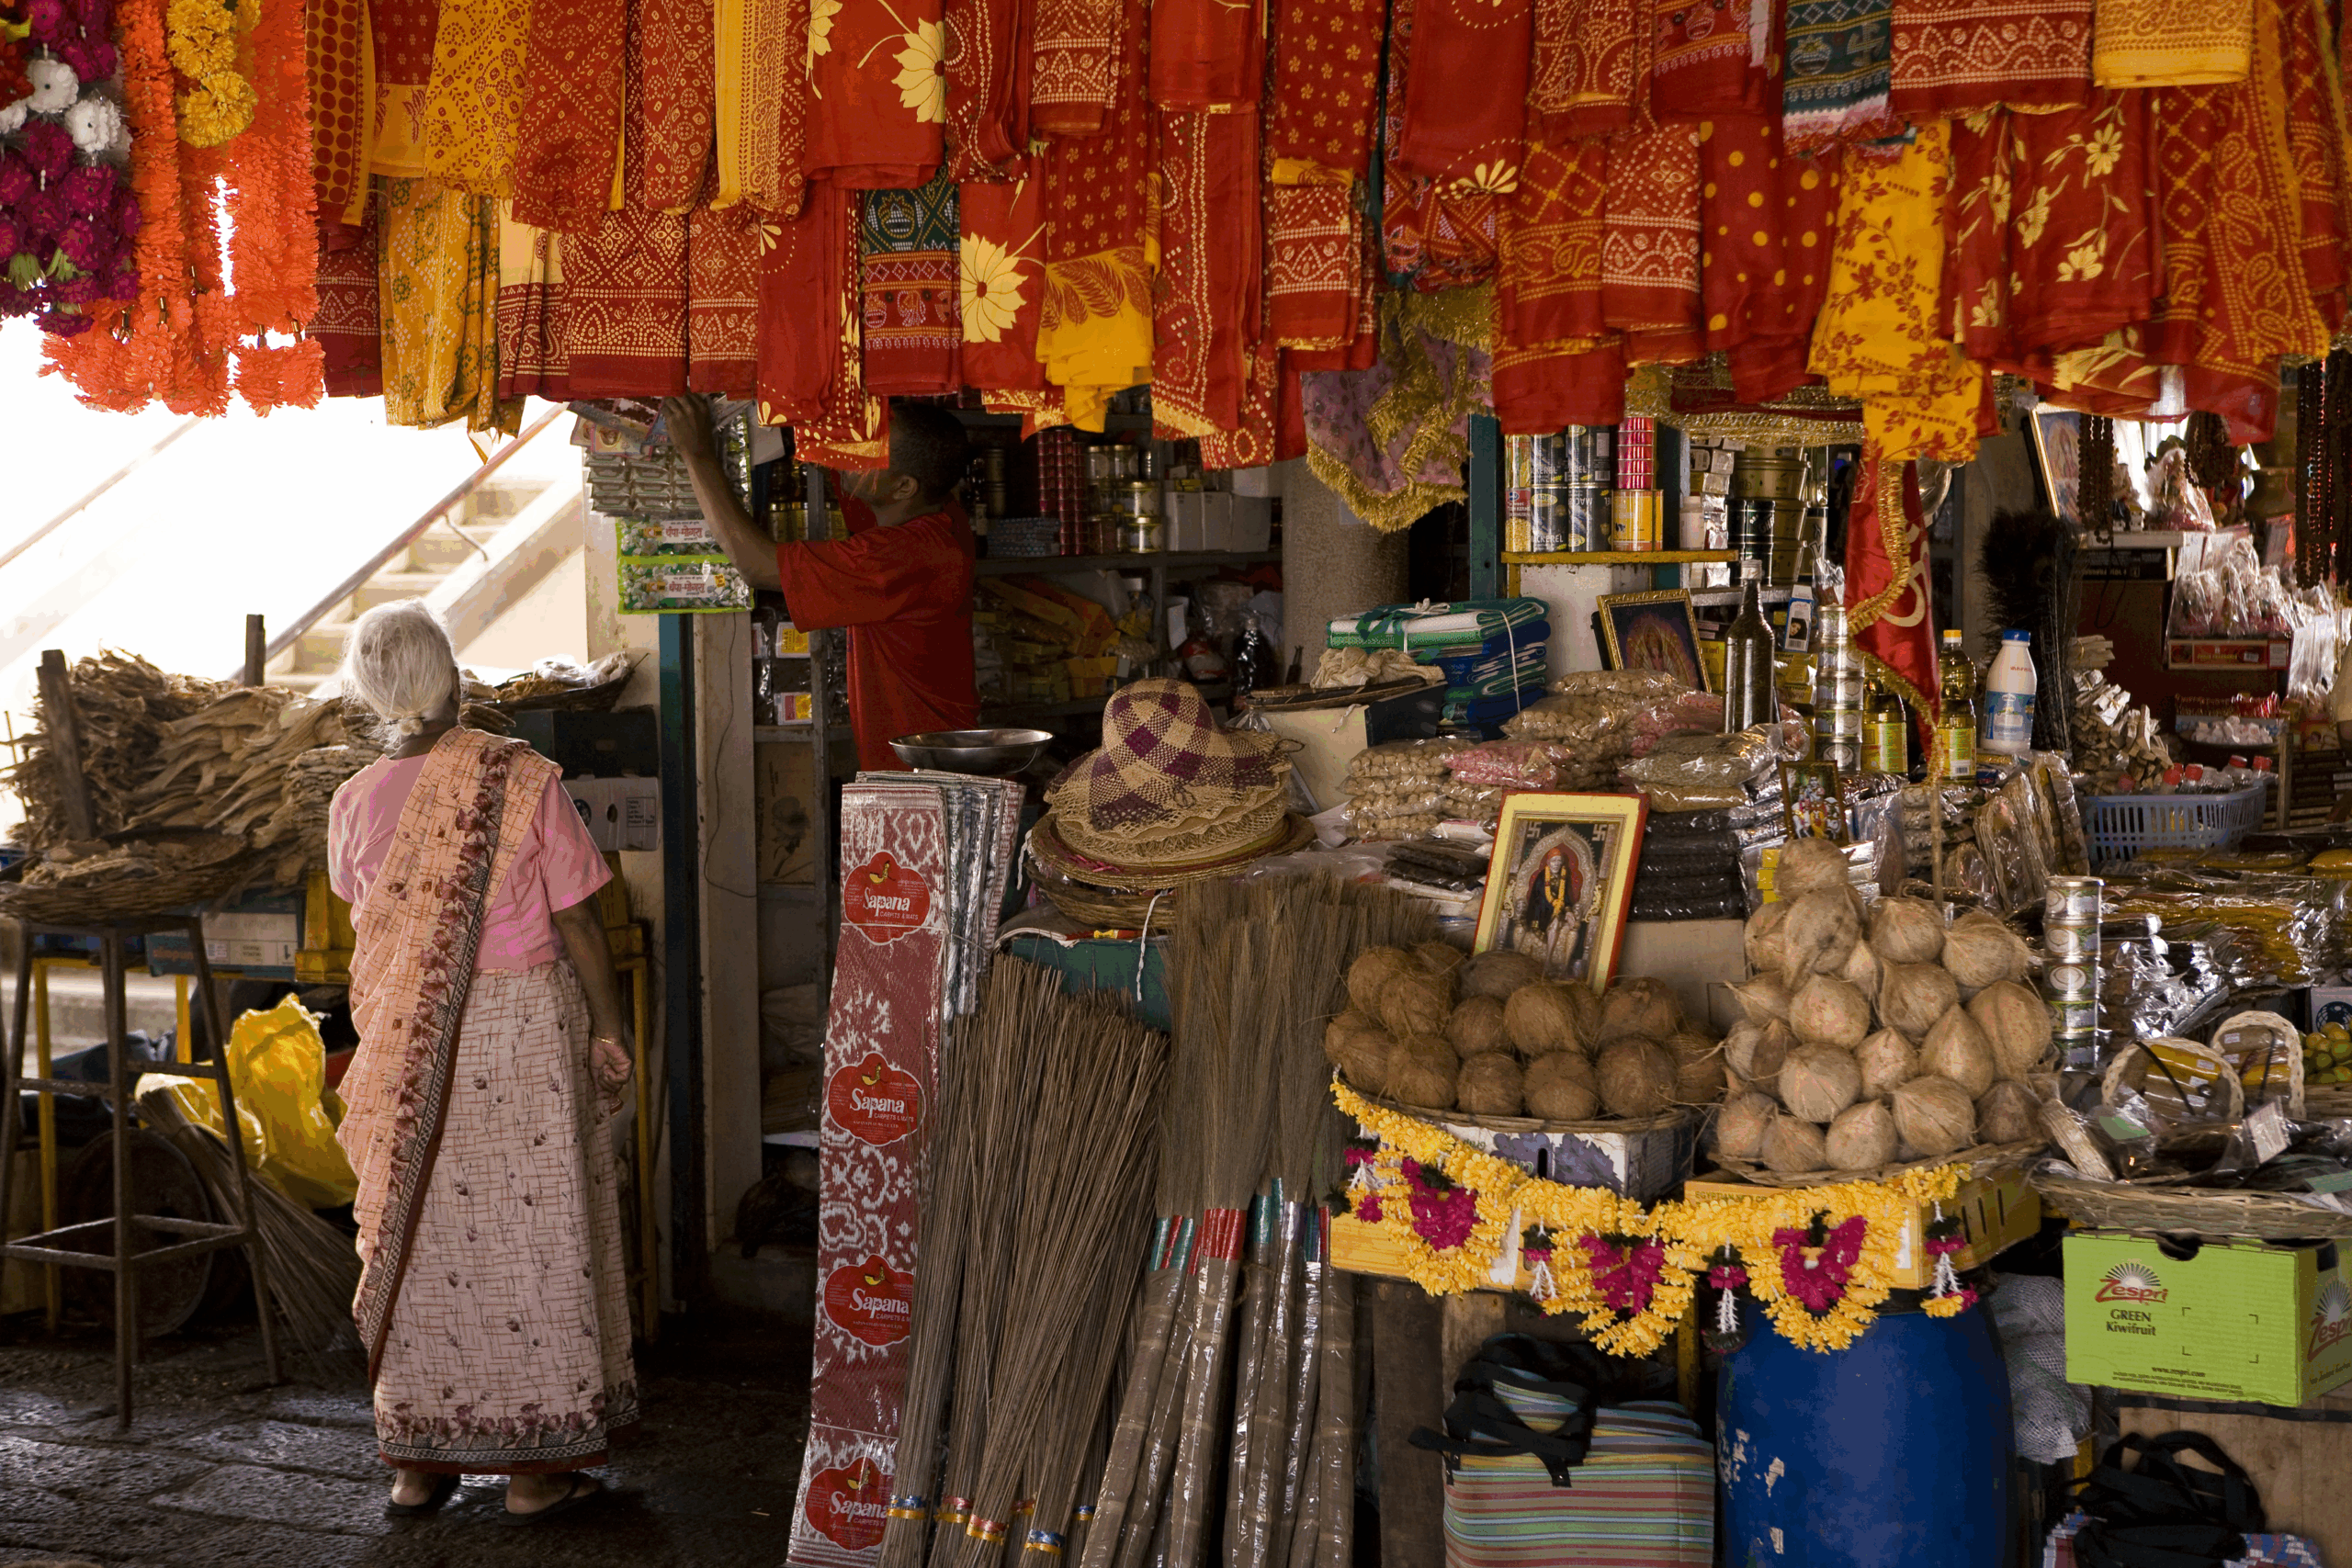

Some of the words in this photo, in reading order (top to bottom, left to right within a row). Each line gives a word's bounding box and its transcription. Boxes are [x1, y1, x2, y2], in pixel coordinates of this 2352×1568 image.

[863, 886, 910, 917] Sapana
[850, 1088, 905, 1119] Sapana
[849, 1288, 910, 1319] Sapana
[2095, 1278, 2169, 1304] Zespri
[876, 1313, 900, 1321] CARPETS
[2110, 1308, 2152, 1323] GREEN
[2106, 1321, 2156, 1337] Kiwifruit
